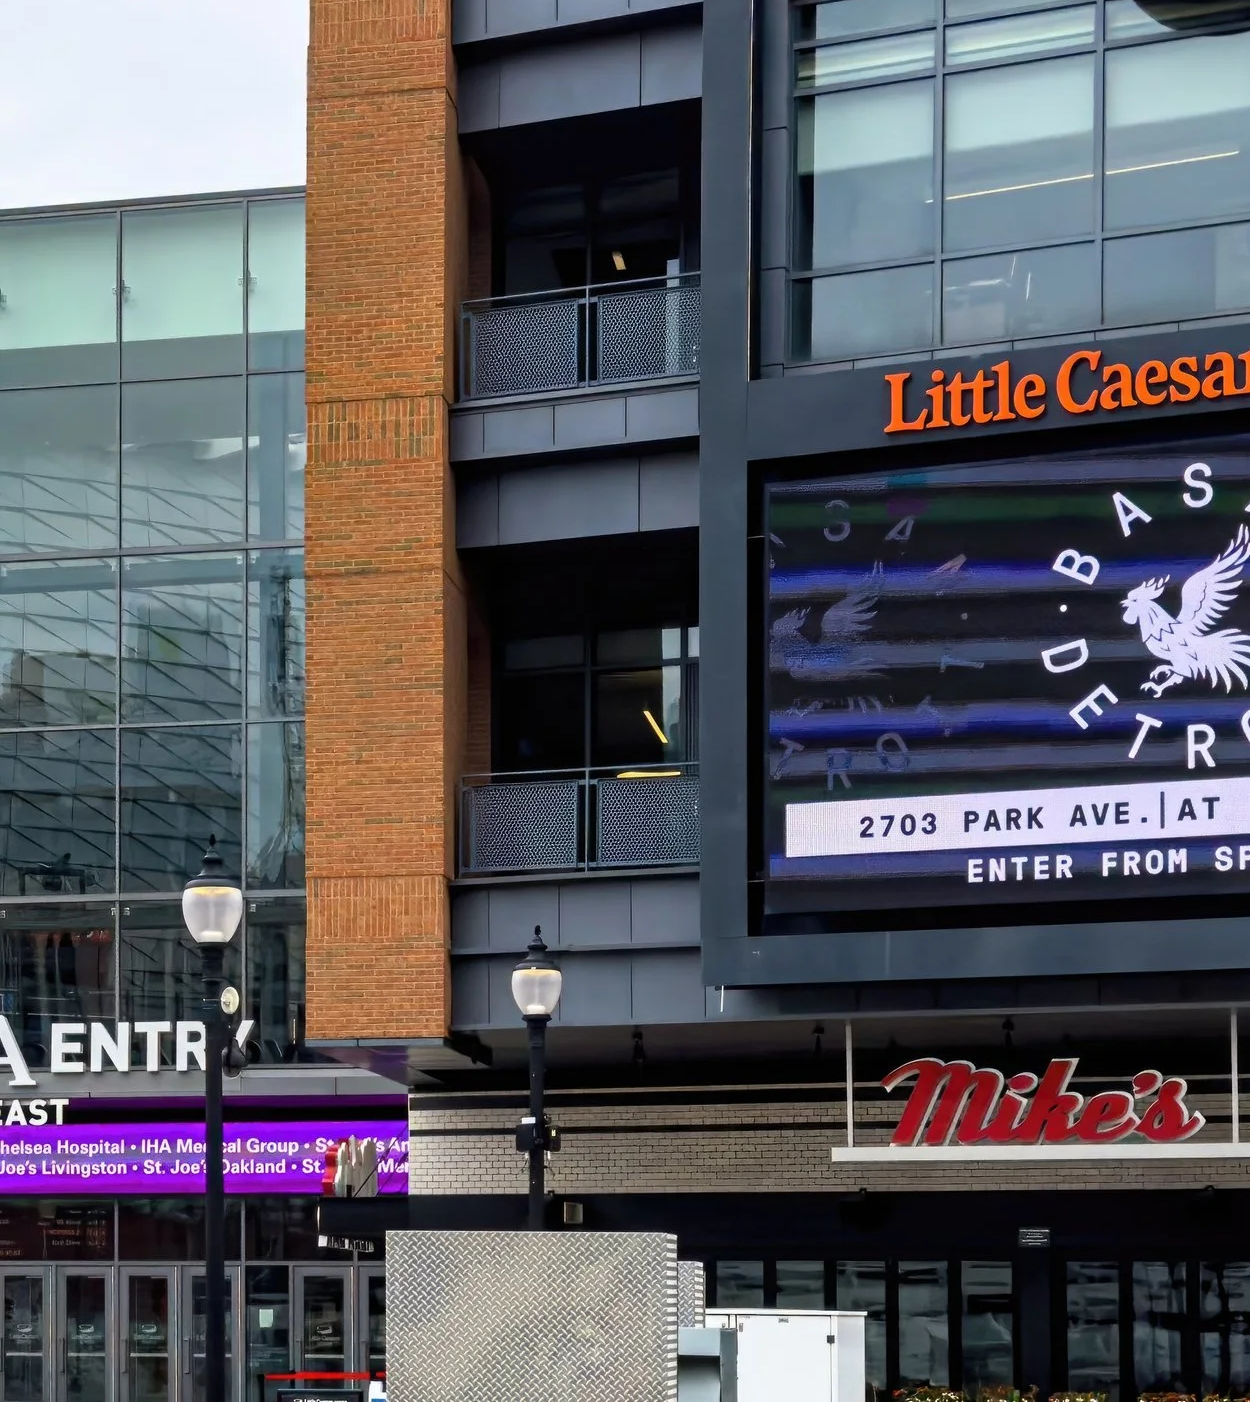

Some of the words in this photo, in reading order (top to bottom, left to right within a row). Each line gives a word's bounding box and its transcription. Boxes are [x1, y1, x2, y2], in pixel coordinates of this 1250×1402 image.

[884, 359, 1047, 434] Little
[859, 812, 937, 839] 2703
[963, 806, 1045, 833] PARK
[1177, 796, 1221, 822] AT
[968, 854, 1074, 883] ENTER
[1101, 848, 1188, 877] FROM
[0, 1099, 70, 1126] AST
[880, 1057, 1207, 1146] Mike's
[0, 1140, 52, 1155] helsea
[57, 1139, 126, 1158] Hospital
[141, 1139, 172, 1154] IHA
[246, 1137, 300, 1156] Group
[0, 1159, 37, 1175] Joe's
[41, 1160, 127, 1178] Livingston
[143, 1159, 166, 1174] St.
[222, 1158, 286, 1174] Oakland
[302, 1158, 325, 1174] St.
